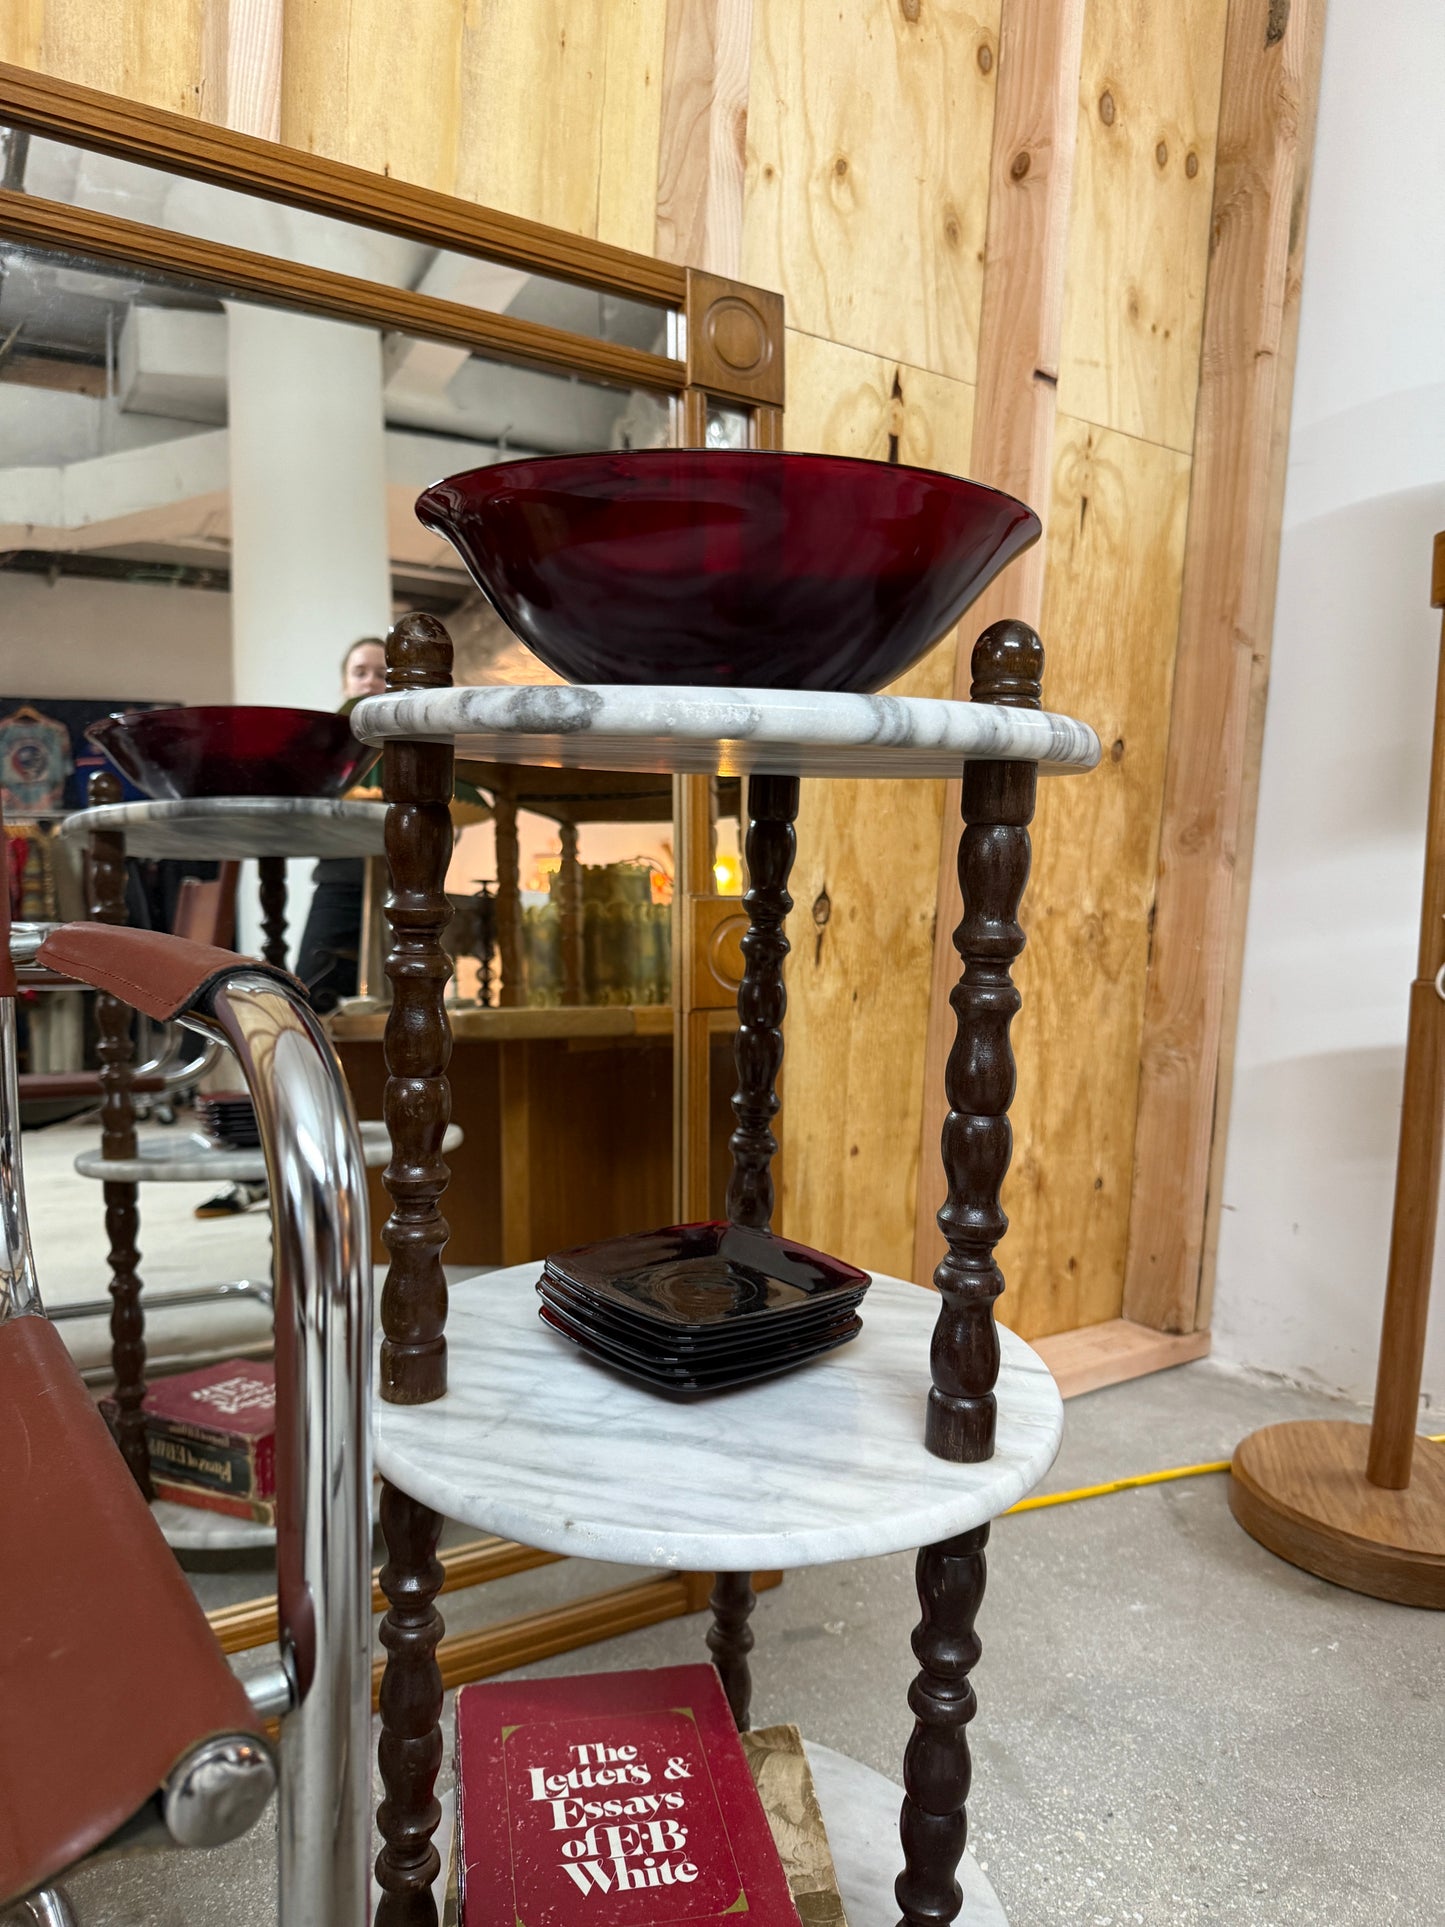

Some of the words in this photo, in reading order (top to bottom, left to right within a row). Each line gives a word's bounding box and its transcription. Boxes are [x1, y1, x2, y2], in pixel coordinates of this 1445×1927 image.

[569, 1743, 638, 1766] The
[526, 1763, 652, 1801] Letters
[663, 1757, 694, 1781] &
[550, 1791, 686, 1831] Essays
[561, 1822, 606, 1859] of
[556, 1851, 699, 1897] White
